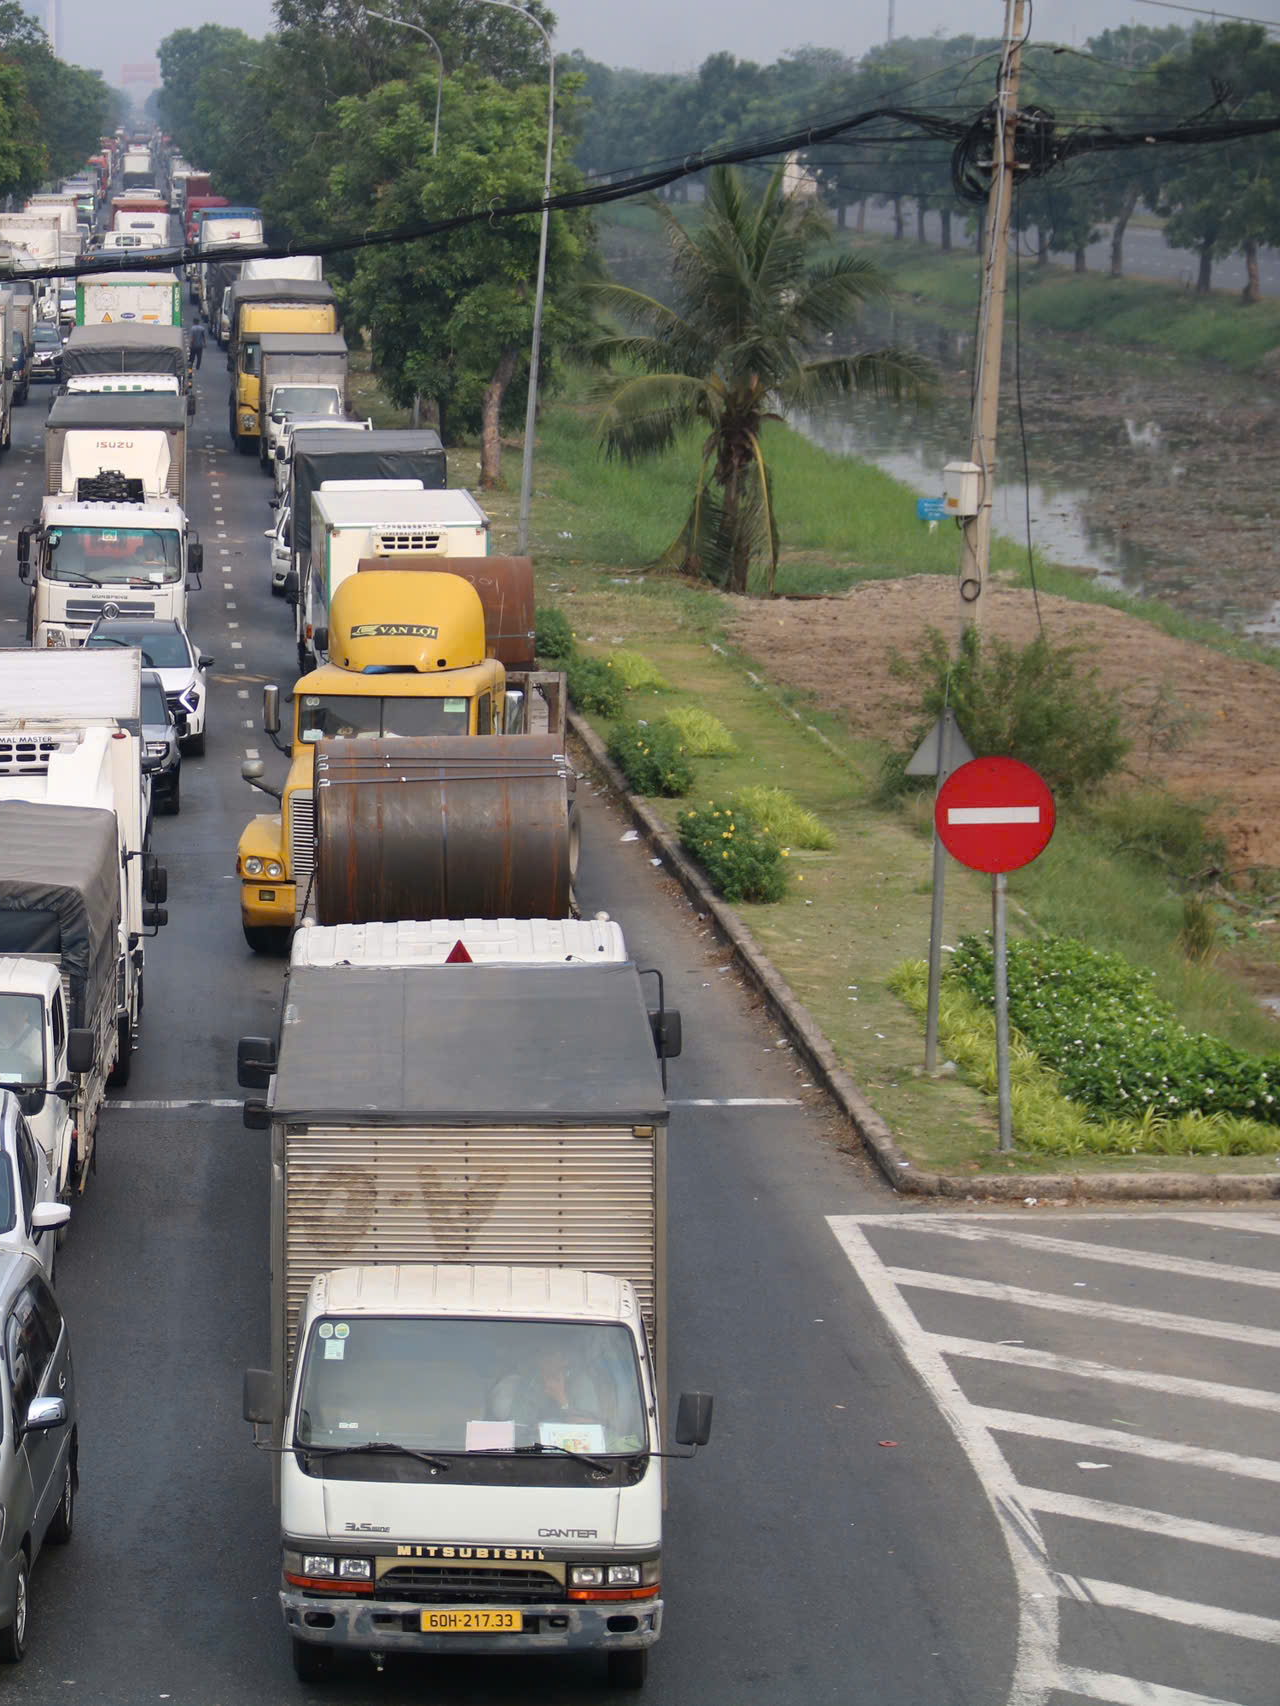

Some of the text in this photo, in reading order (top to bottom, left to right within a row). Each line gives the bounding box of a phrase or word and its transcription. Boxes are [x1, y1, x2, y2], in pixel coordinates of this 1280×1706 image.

[96, 441, 134, 449] ISUZU
[379, 625, 437, 638] VẠN LỢI
[19, 735, 53, 743] MASTER
[537, 1528, 598, 1539] CANTER
[429, 1613, 514, 1628] 60H-217.33
